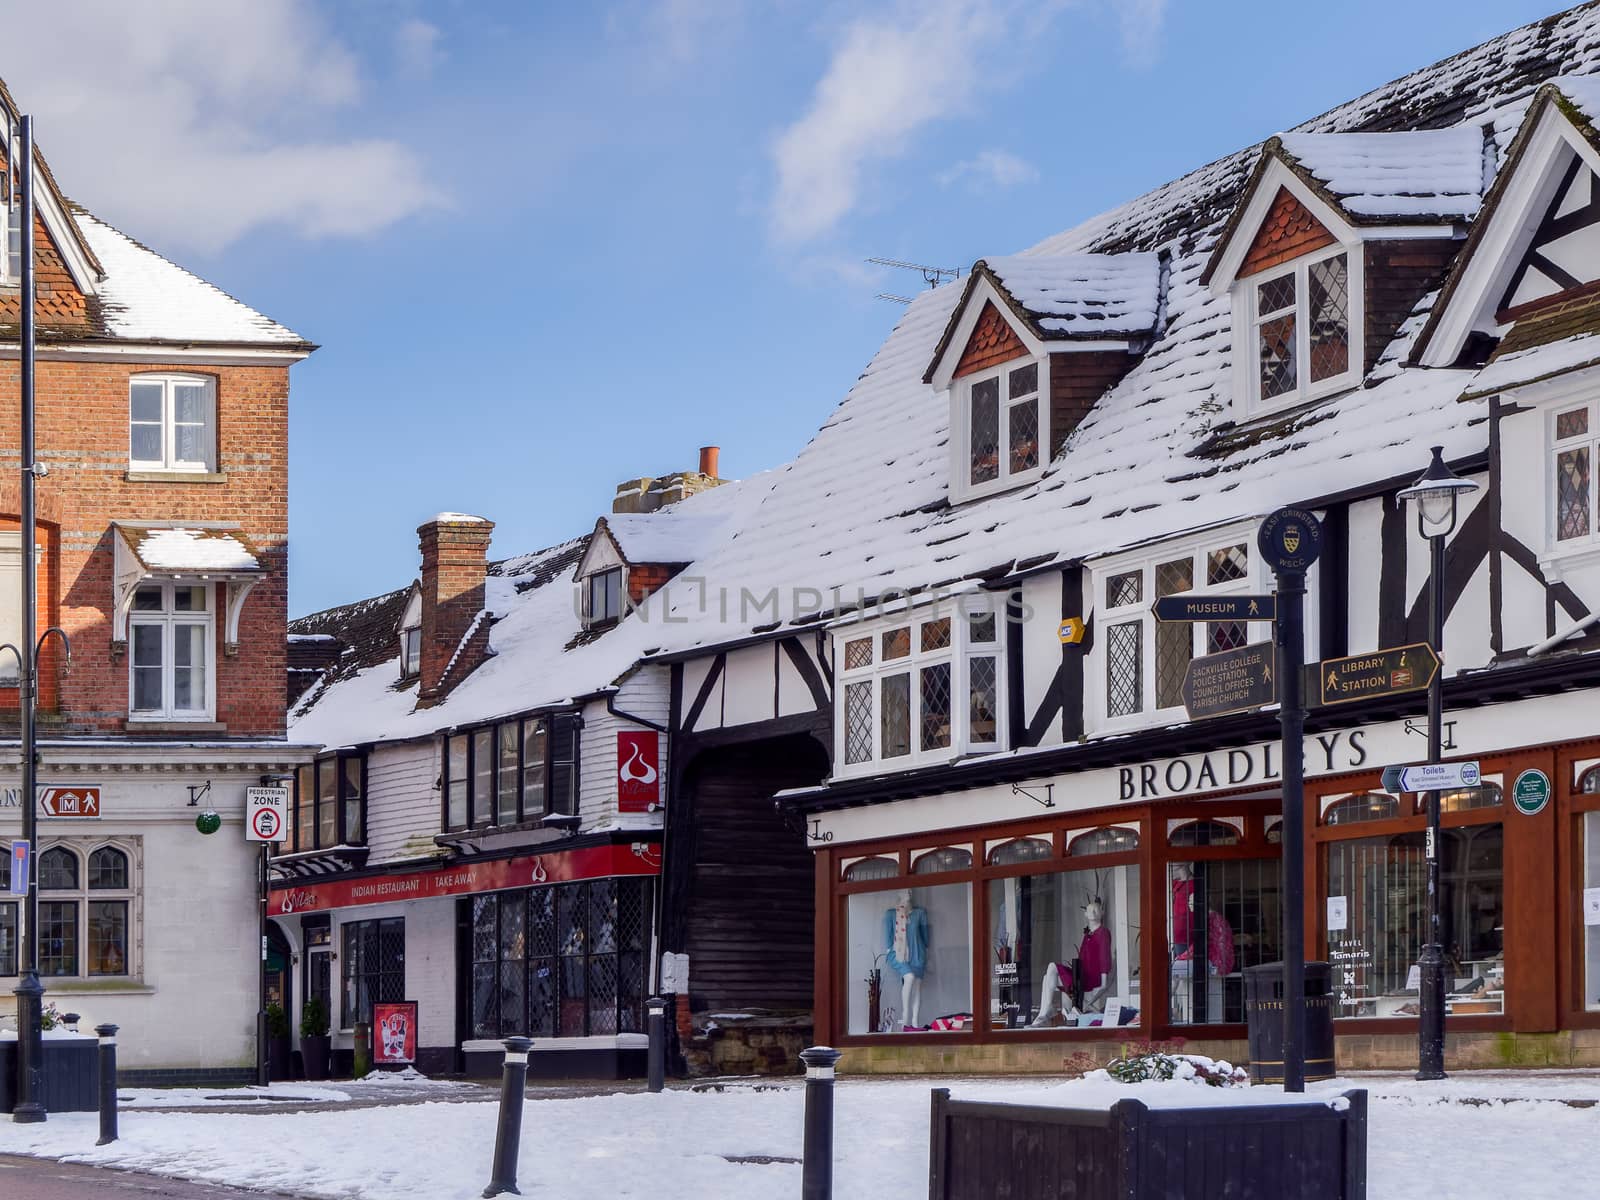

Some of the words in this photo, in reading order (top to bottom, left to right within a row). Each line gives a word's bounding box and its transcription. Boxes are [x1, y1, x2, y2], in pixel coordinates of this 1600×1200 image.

[1187, 603, 1236, 613] MUSEUM
[1193, 662, 1228, 678] SACKVILLE
[1230, 654, 1261, 669] COLLEGE
[1342, 657, 1385, 673] LIBRARY
[1193, 675, 1217, 689] POLICE
[1219, 668, 1248, 682] STATION
[1193, 685, 1223, 699] COUNCIL
[1225, 677, 1255, 691] OFFICES
[1342, 675, 1386, 692] STATION
[1193, 695, 1218, 709] PARISH
[1220, 689, 1249, 703] CHURCH
[1120, 731, 1366, 800] BROADLYS
[1422, 767, 1445, 775] Toilets
[253, 796, 281, 806] ZONE
[351, 885, 376, 898] INDIAN
[377, 880, 420, 896] RESTAURANT
[435, 875, 453, 888] TAKE
[454, 871, 477, 886] AWAY
